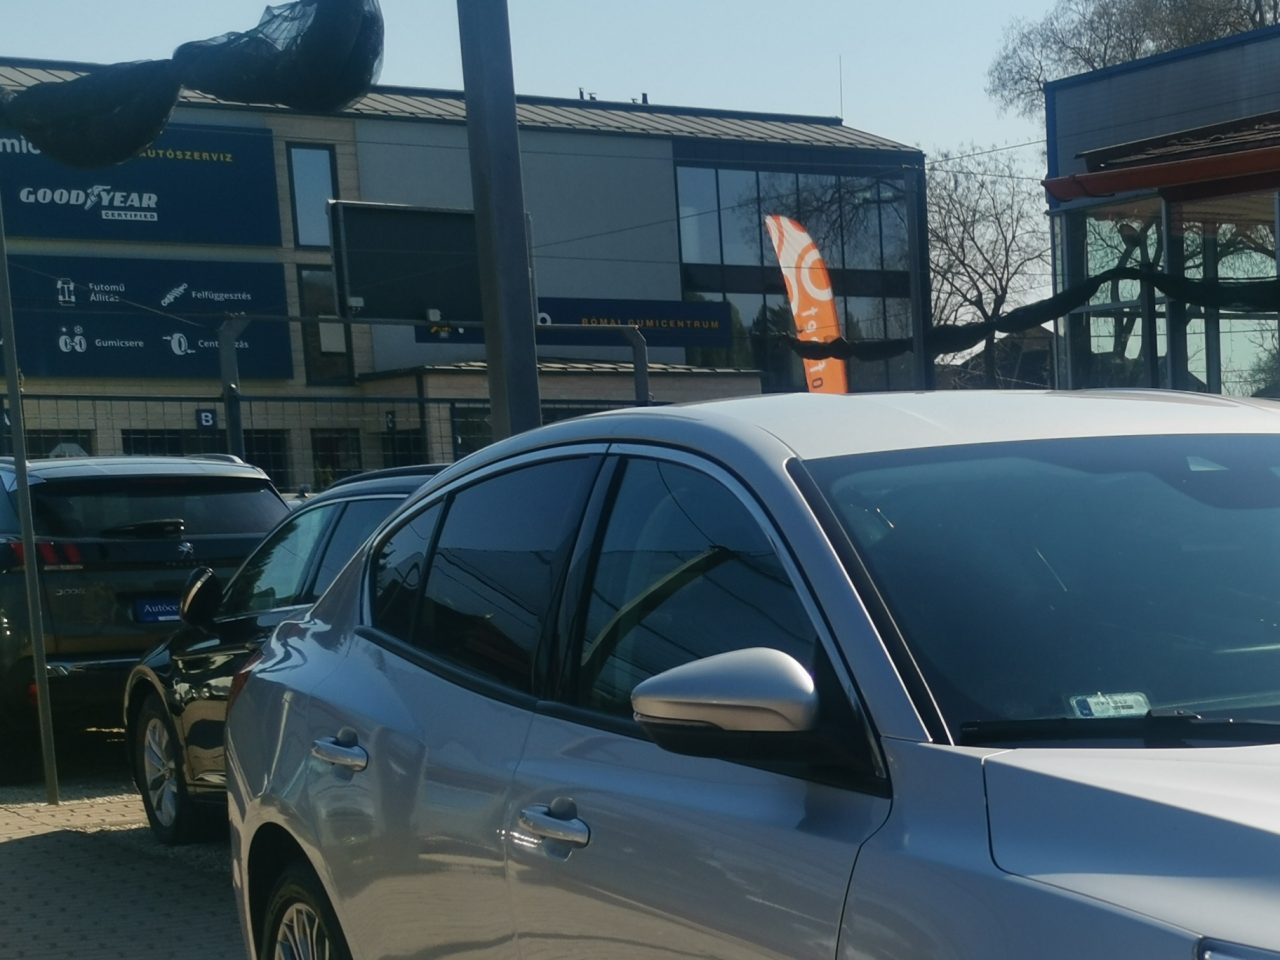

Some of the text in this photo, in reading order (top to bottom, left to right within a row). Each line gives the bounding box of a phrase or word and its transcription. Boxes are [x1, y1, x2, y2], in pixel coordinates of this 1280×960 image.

[19, 185, 158, 210] GOODYEAR
[103, 212, 157, 220] CERTIFIED
[95, 338, 144, 348] Gumicsere
[201, 412, 213, 426] B
